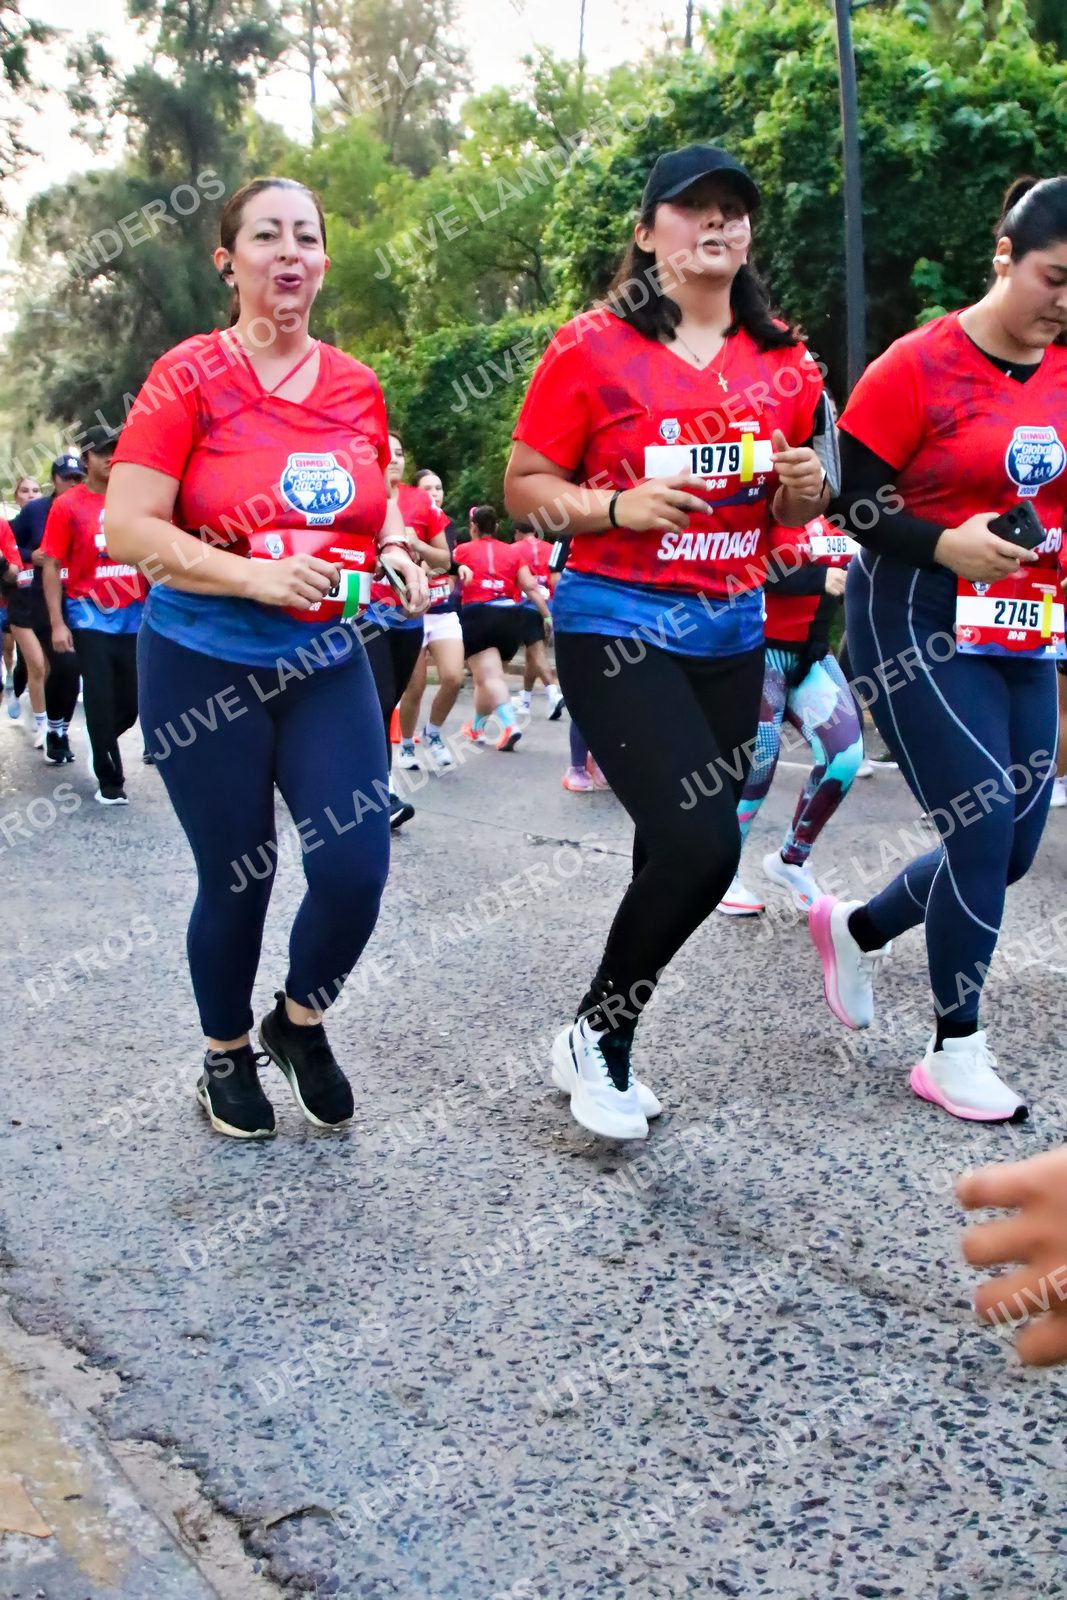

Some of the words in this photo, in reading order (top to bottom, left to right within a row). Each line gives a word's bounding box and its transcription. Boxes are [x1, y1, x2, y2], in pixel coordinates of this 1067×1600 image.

[1020, 432, 1051, 440] BIMBO
[1022, 444, 1052, 456] Global
[295, 459, 331, 468] BIMBO
[690, 444, 740, 475] 1979
[1015, 453, 1040, 465] Race
[299, 470, 335, 481] Global
[292, 480, 323, 491] Race
[309, 516, 333, 525] 2026
[657, 528, 761, 561] SANTIAGO
[826, 538, 847, 553] 3485
[994, 600, 1040, 627] 2745
